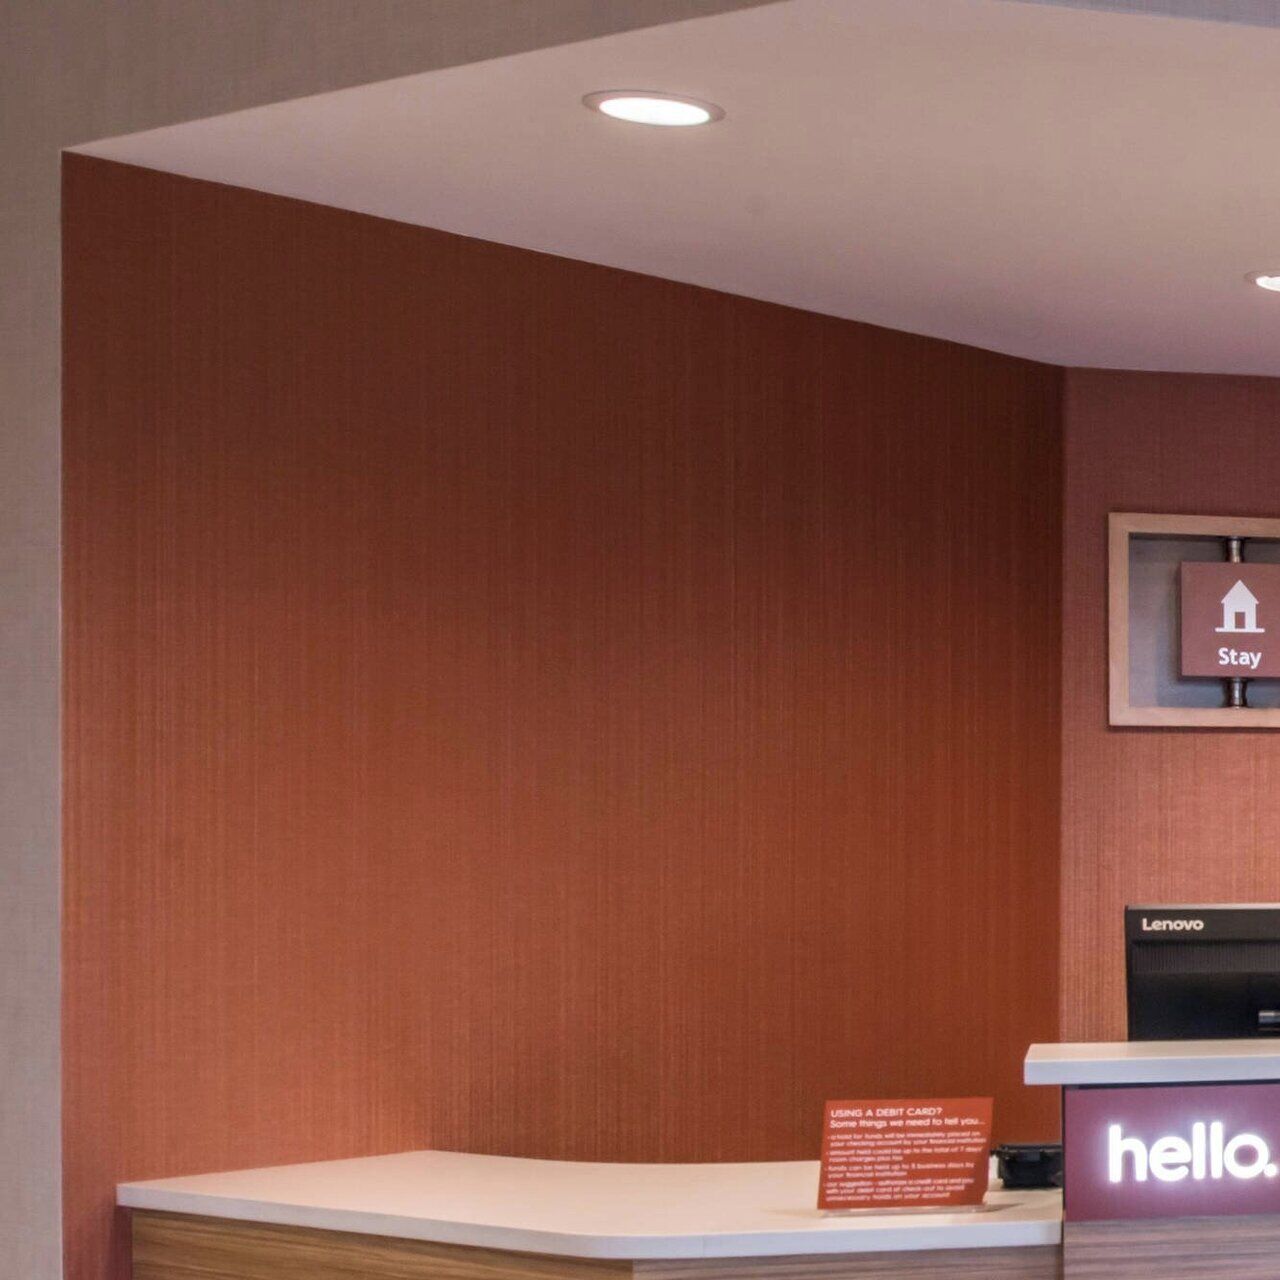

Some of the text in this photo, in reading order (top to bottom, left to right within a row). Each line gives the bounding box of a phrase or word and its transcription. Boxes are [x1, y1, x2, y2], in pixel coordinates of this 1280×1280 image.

[1217, 646, 1263, 670] Stay
[1142, 917, 1205, 932] Lenovo
[830, 1106, 943, 1118] USING A DEBIT CARD?
[830, 1119, 858, 1129] Some
[859, 1118, 888, 1130] things
[890, 1120, 904, 1128] we
[905, 1118, 931, 1127] need
[932, 1118, 943, 1126] to
[1107, 1121, 1279, 1184] hello.
